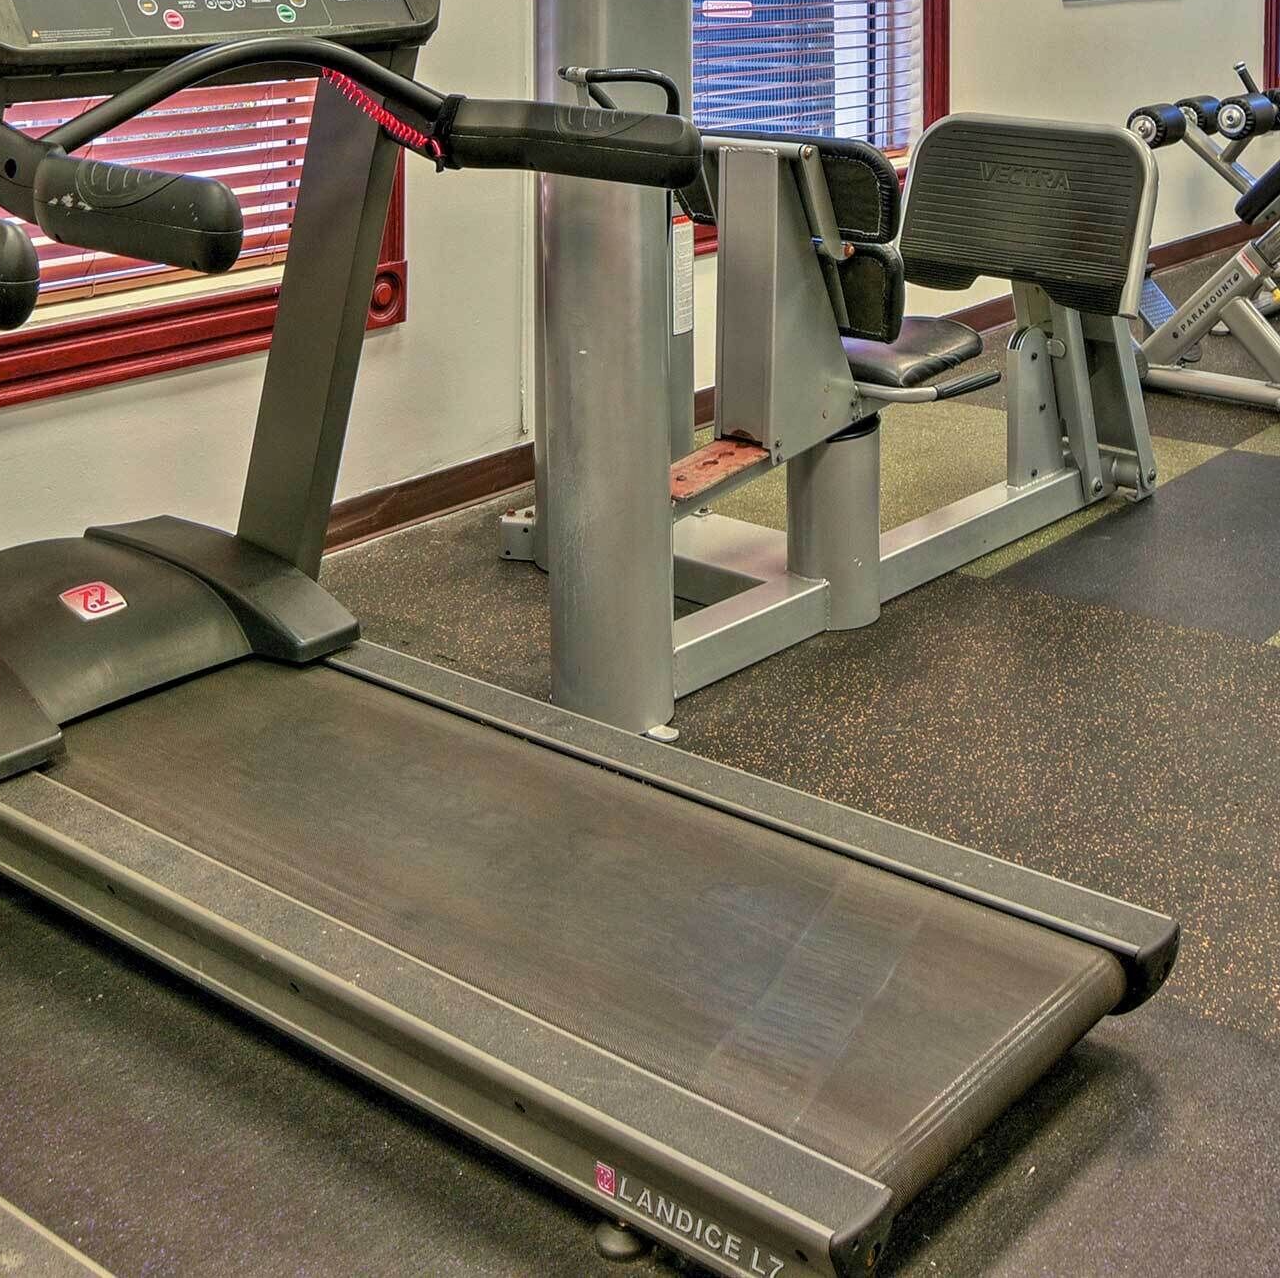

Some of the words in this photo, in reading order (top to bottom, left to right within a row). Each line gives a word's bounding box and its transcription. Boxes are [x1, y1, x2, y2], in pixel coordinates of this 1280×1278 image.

[978, 160, 1071, 192] VECTRA
[1180, 278, 1234, 331] PARAMOUNT
[619, 1175, 742, 1262] LANDICE
[751, 1245, 785, 1278] L7
